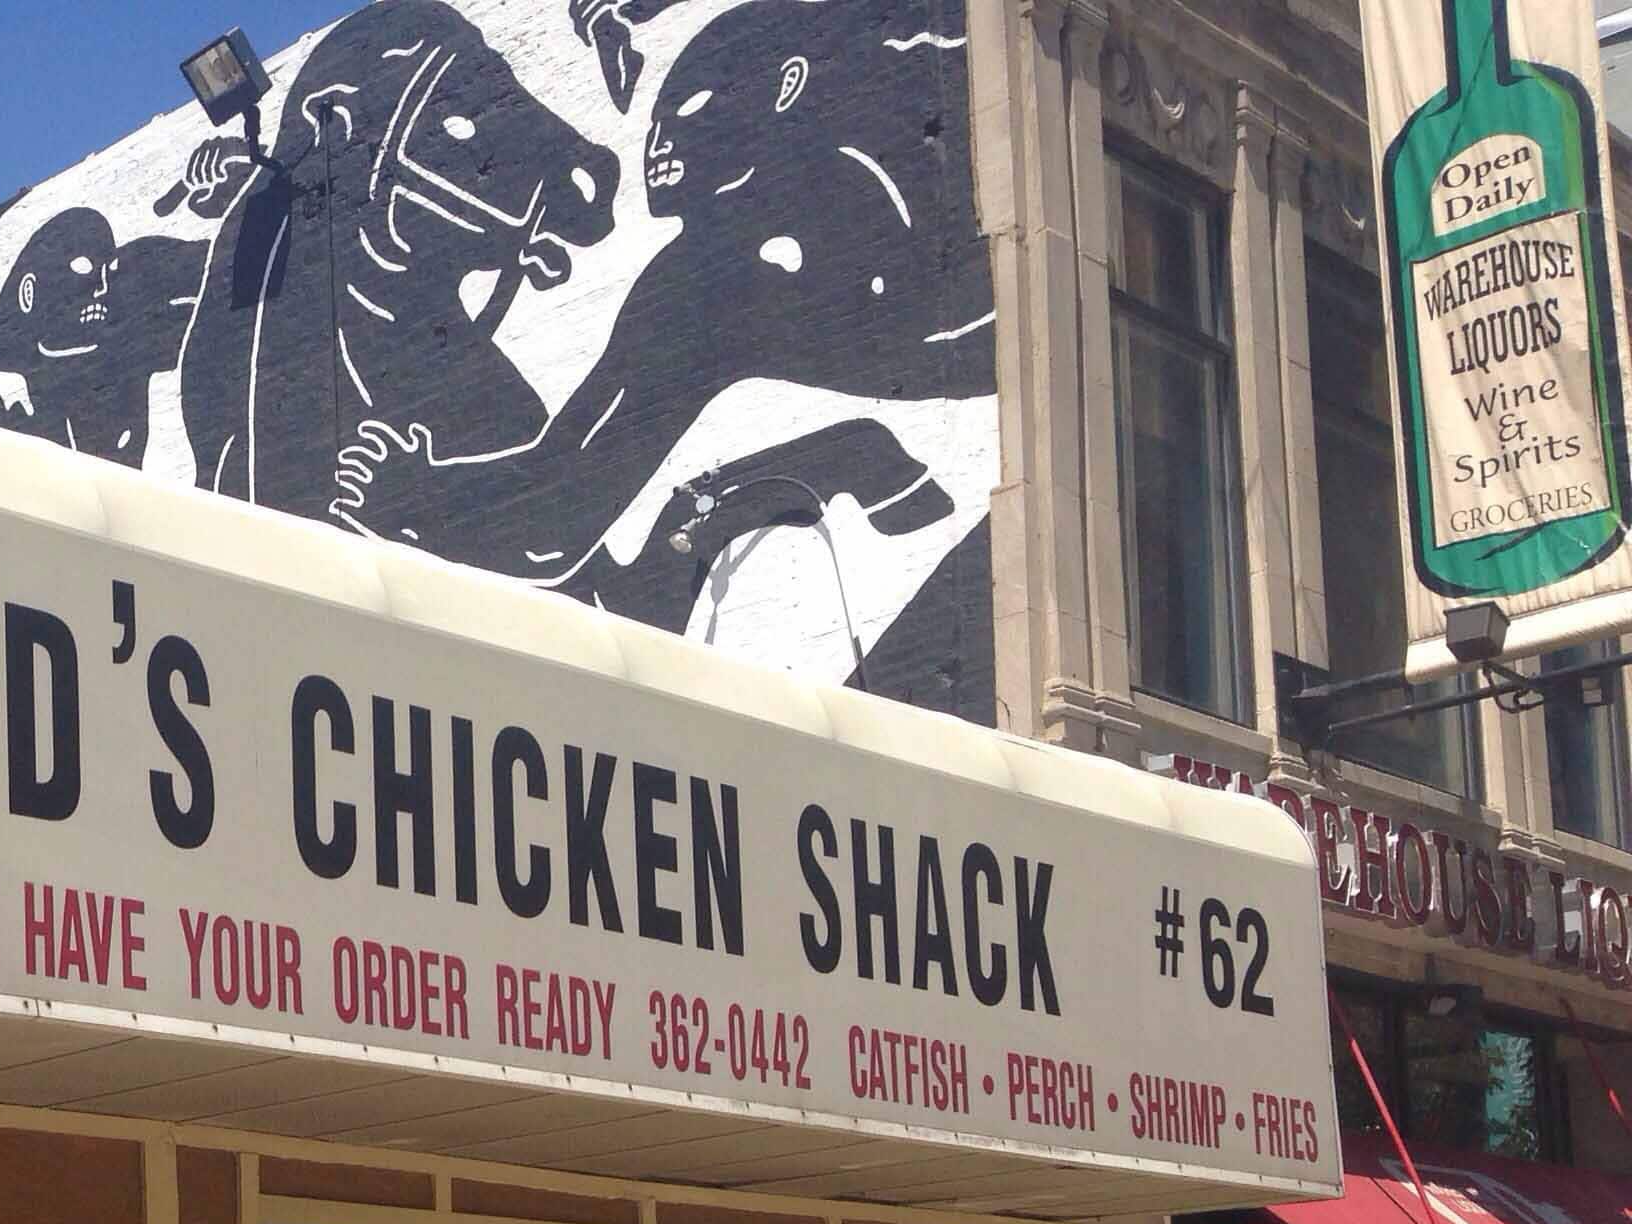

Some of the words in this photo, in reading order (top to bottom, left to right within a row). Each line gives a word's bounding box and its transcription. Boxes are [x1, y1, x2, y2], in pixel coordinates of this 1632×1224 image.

[1441, 145, 1532, 188] Open
[1444, 175, 1536, 223] Daily
[1423, 239, 1575, 321] WAREHOUSE
[1446, 297, 1563, 376] LIQUORS
[1463, 378, 1560, 422] Wine
[1498, 412, 1529, 443] &
[1453, 434, 1582, 488] Spirits
[1450, 482, 1594, 533] GROCERIES
[291, 674, 745, 957] CHICKEN
[797, 803, 1062, 1017] SHACK
[1172, 753, 1534, 950] EHOUSE
[23, 881, 148, 991] HAVE
[178, 908, 305, 1016] YOUR
[332, 936, 468, 1040] ORDER
[495, 963, 616, 1060] READY
[648, 990, 811, 1091] 362-0442
[848, 1025, 969, 1114] CATFISH
[1008, 1052, 1094, 1132] PERCH
[1129, 1072, 1226, 1149] SHRIMP
[1252, 1092, 1318, 1163] FRIES
